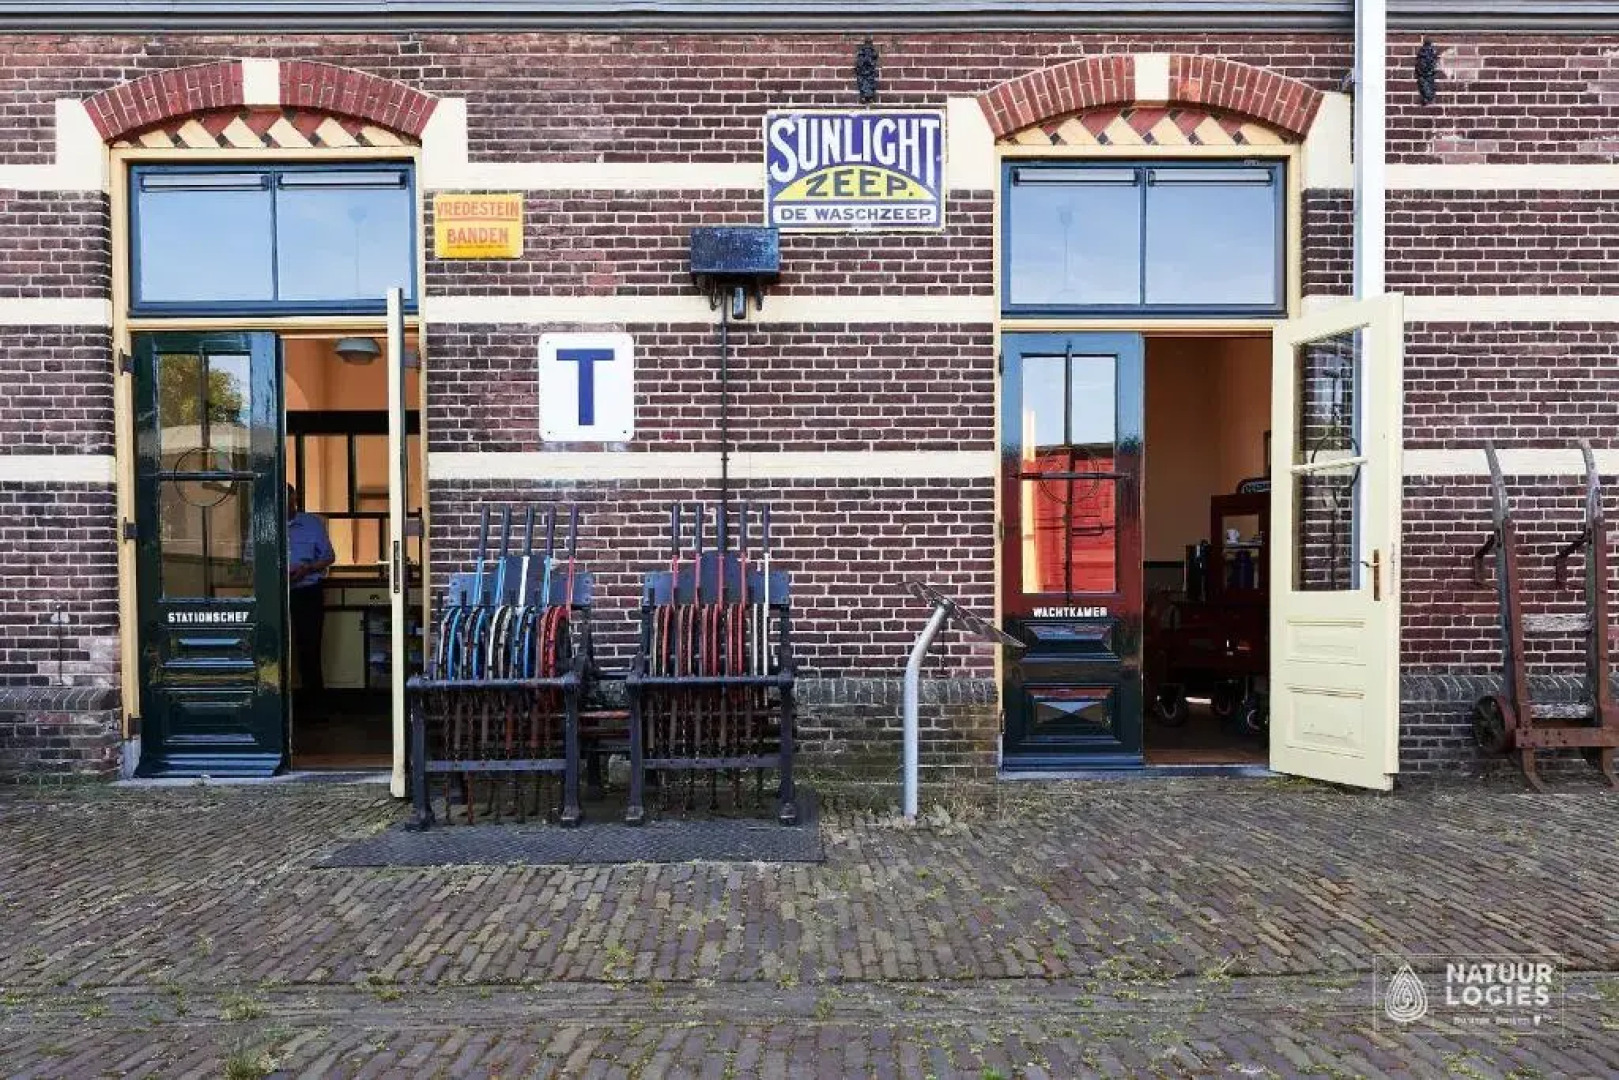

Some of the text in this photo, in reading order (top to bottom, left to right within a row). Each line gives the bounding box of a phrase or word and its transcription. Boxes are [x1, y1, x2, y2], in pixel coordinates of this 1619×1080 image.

[769, 118, 940, 189] SUNLIGHT
[805, 168, 914, 197] ZEEP.
[436, 201, 519, 217] VREDESTEIN
[780, 208, 931, 221] DE WASCHZEEP.
[447, 227, 509, 244] BANDEN
[556, 348, 615, 426] T
[168, 611, 249, 624] STATIONSCHEF
[1032, 606, 1108, 618] WACHTKAMER
